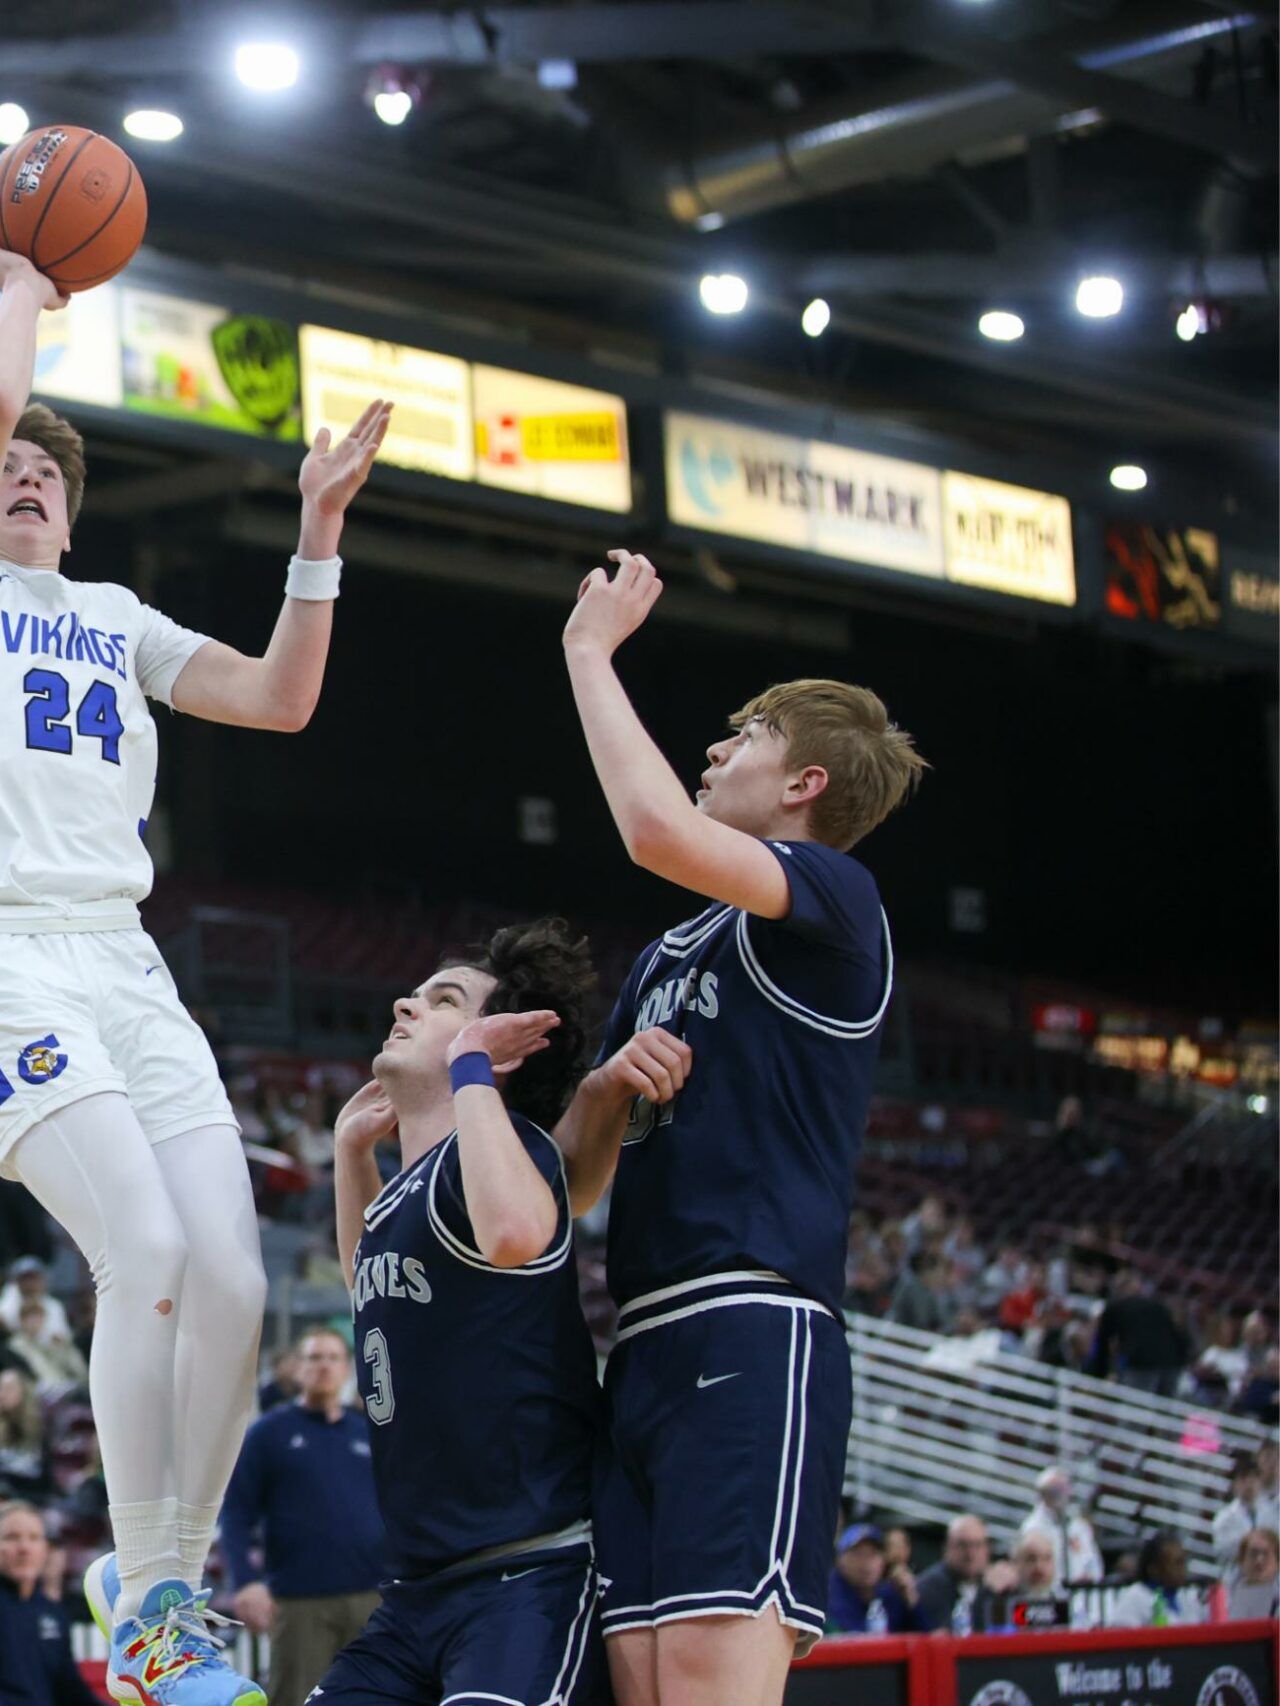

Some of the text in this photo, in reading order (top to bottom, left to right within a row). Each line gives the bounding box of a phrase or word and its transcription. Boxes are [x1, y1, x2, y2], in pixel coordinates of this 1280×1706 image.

[741, 455, 928, 533] WESTMARK
[1, 610, 127, 681] VIKINGS
[23, 668, 124, 766] 24
[363, 1327, 396, 1426] 3
[1055, 1662, 1122, 1697] Welcome
